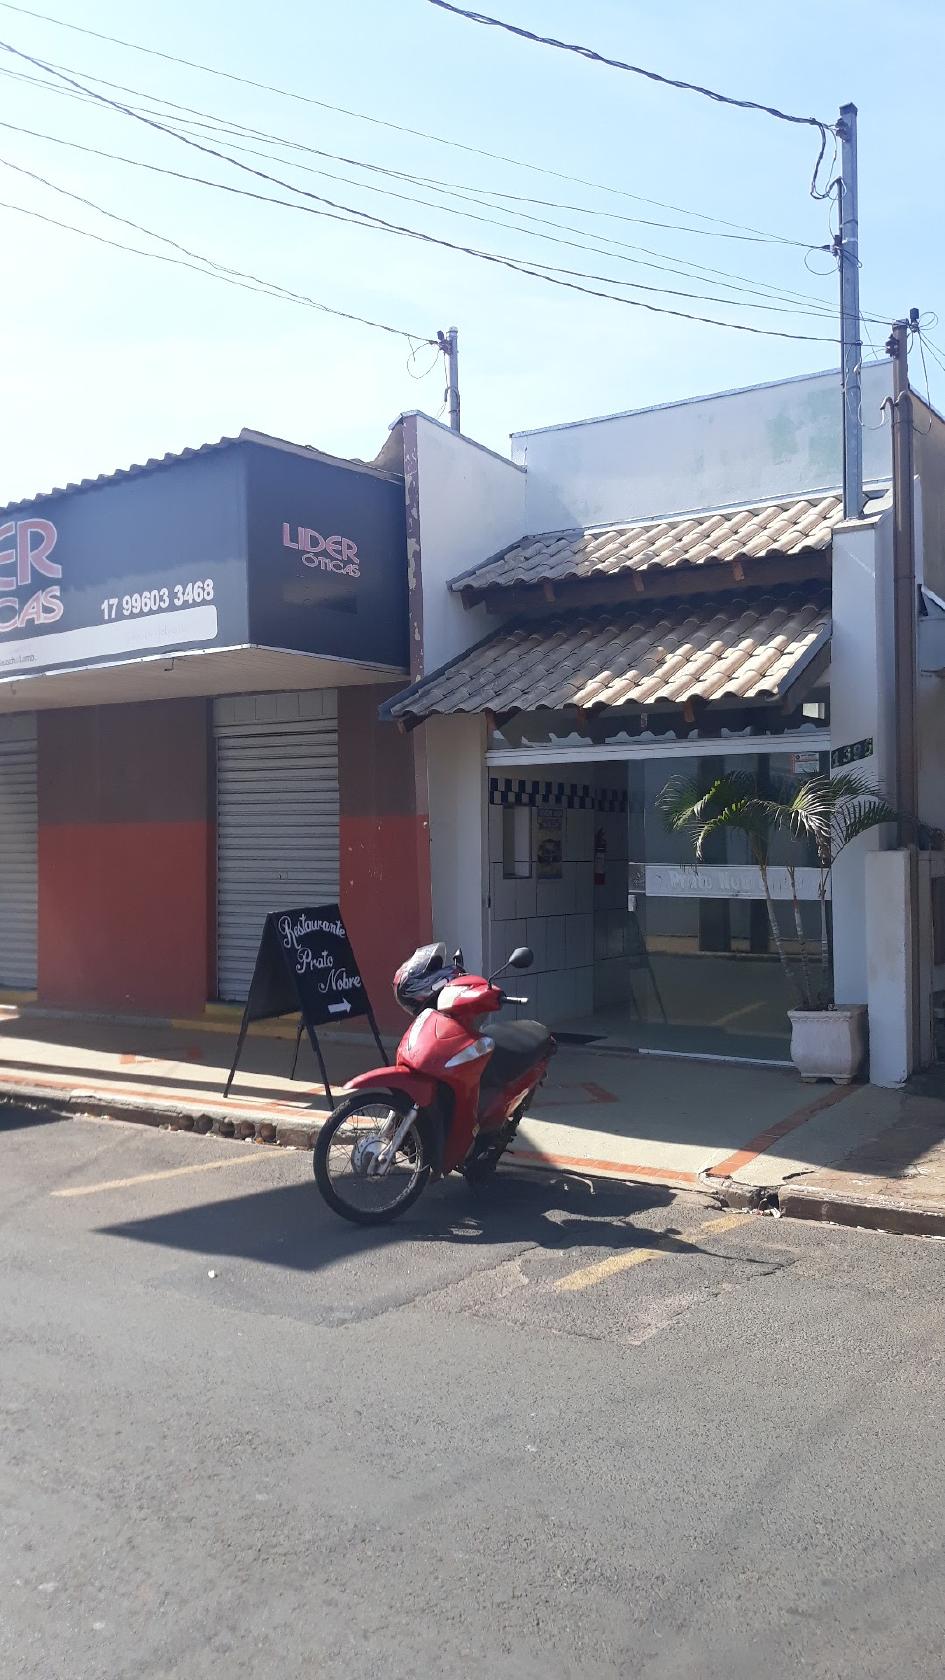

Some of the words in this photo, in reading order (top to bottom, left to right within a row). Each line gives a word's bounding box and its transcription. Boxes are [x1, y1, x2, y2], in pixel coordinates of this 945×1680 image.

[283, 522, 360, 564] LIDER
[101, 598, 119, 620] 17
[122, 587, 170, 616] 99603
[173, 578, 214, 606] 3468
[278, 913, 346, 949] Restaurante
[295, 947, 334, 974] Prato
[318, 967, 362, 993] Nobre
